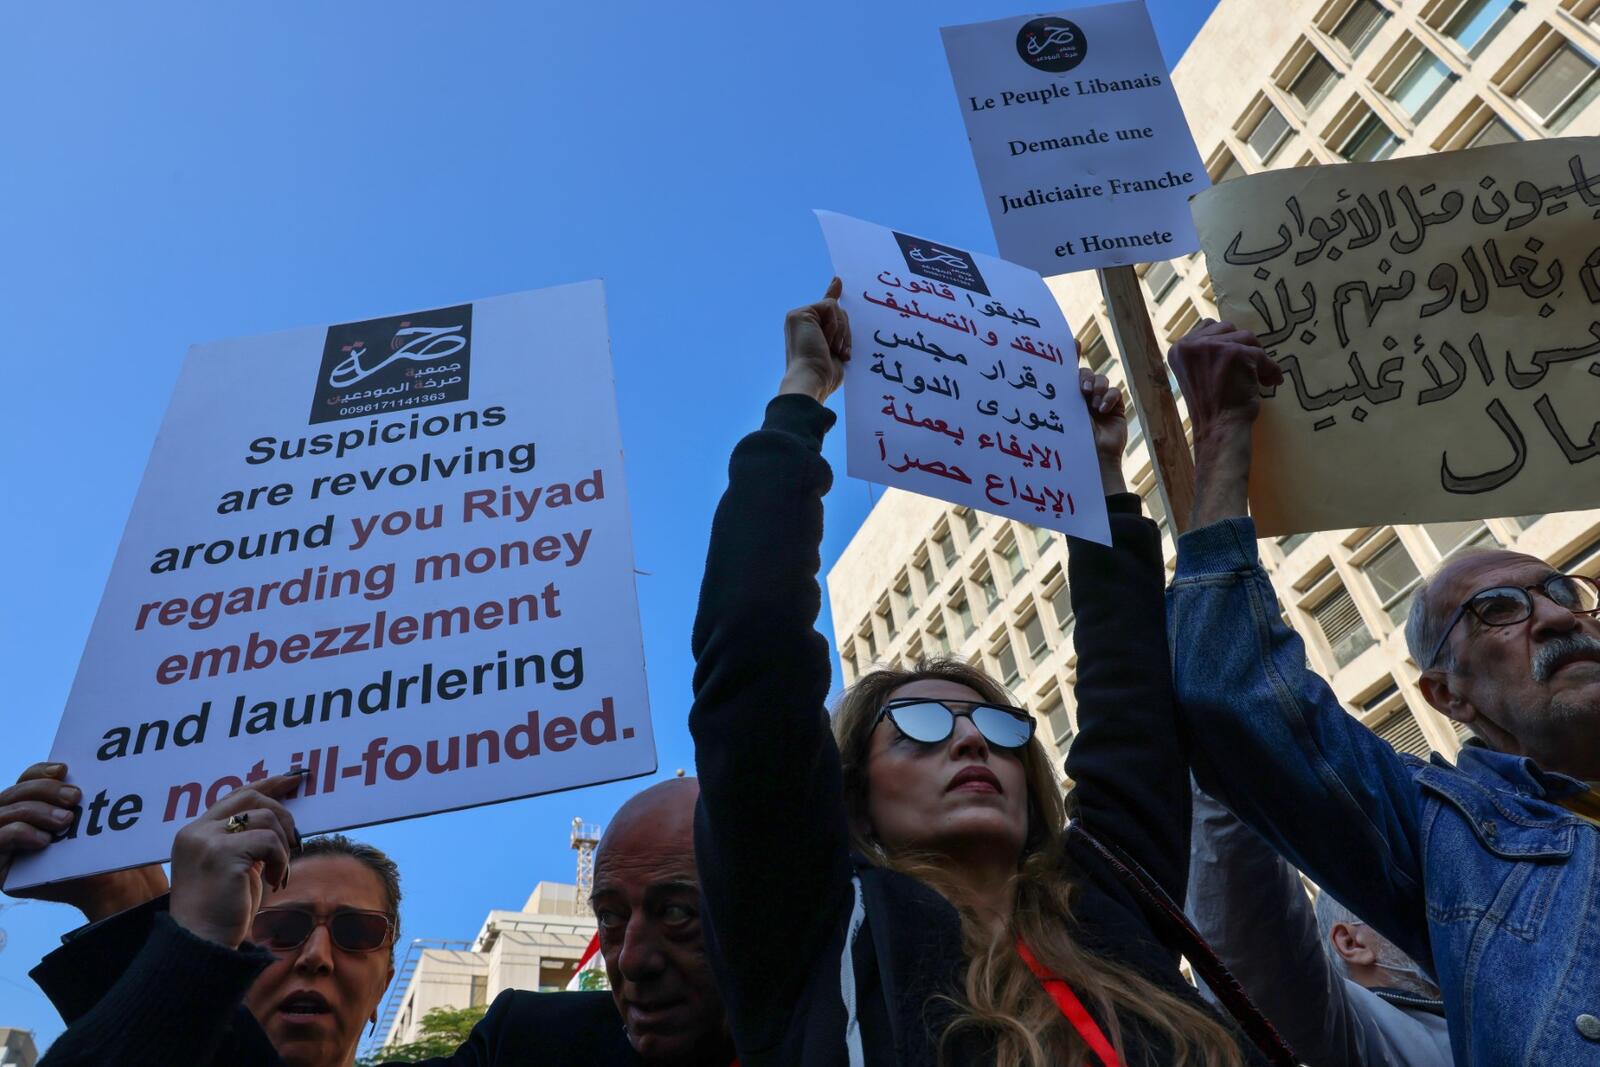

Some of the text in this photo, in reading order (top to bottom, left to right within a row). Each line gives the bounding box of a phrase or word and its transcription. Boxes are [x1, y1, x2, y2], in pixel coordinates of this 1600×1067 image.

[969, 73, 1161, 111] Le Peuple Libanais
[1008, 128, 1153, 156] Demande une
[1000, 171, 1194, 214] Judiciaire Franche
[1055, 231, 1173, 257] et Honnete
[877, 271, 956, 301] قانون
[960, 293, 1041, 328] طبقوا
[405, 362, 461, 378] جمعية
[873, 329, 1057, 400] وقرار مجلس
[1010, 334, 1064, 366] النقد
[327, 376, 462, 406] صرخة المودعين
[870, 352, 960, 400] الدولة
[339, 391, 446, 416] 0096171141363
[881, 394, 964, 445] بعملة
[245, 404, 507, 465] Suspicions
[217, 442, 536, 515] are revolving
[150, 469, 605, 574] around you Riyad
[135, 528, 593, 632] regarding money
[156, 582, 561, 686] embezzlement
[96, 647, 584, 762] and laundrlering
[162, 759, 269, 822] not
[287, 697, 635, 799] ill-founded.
